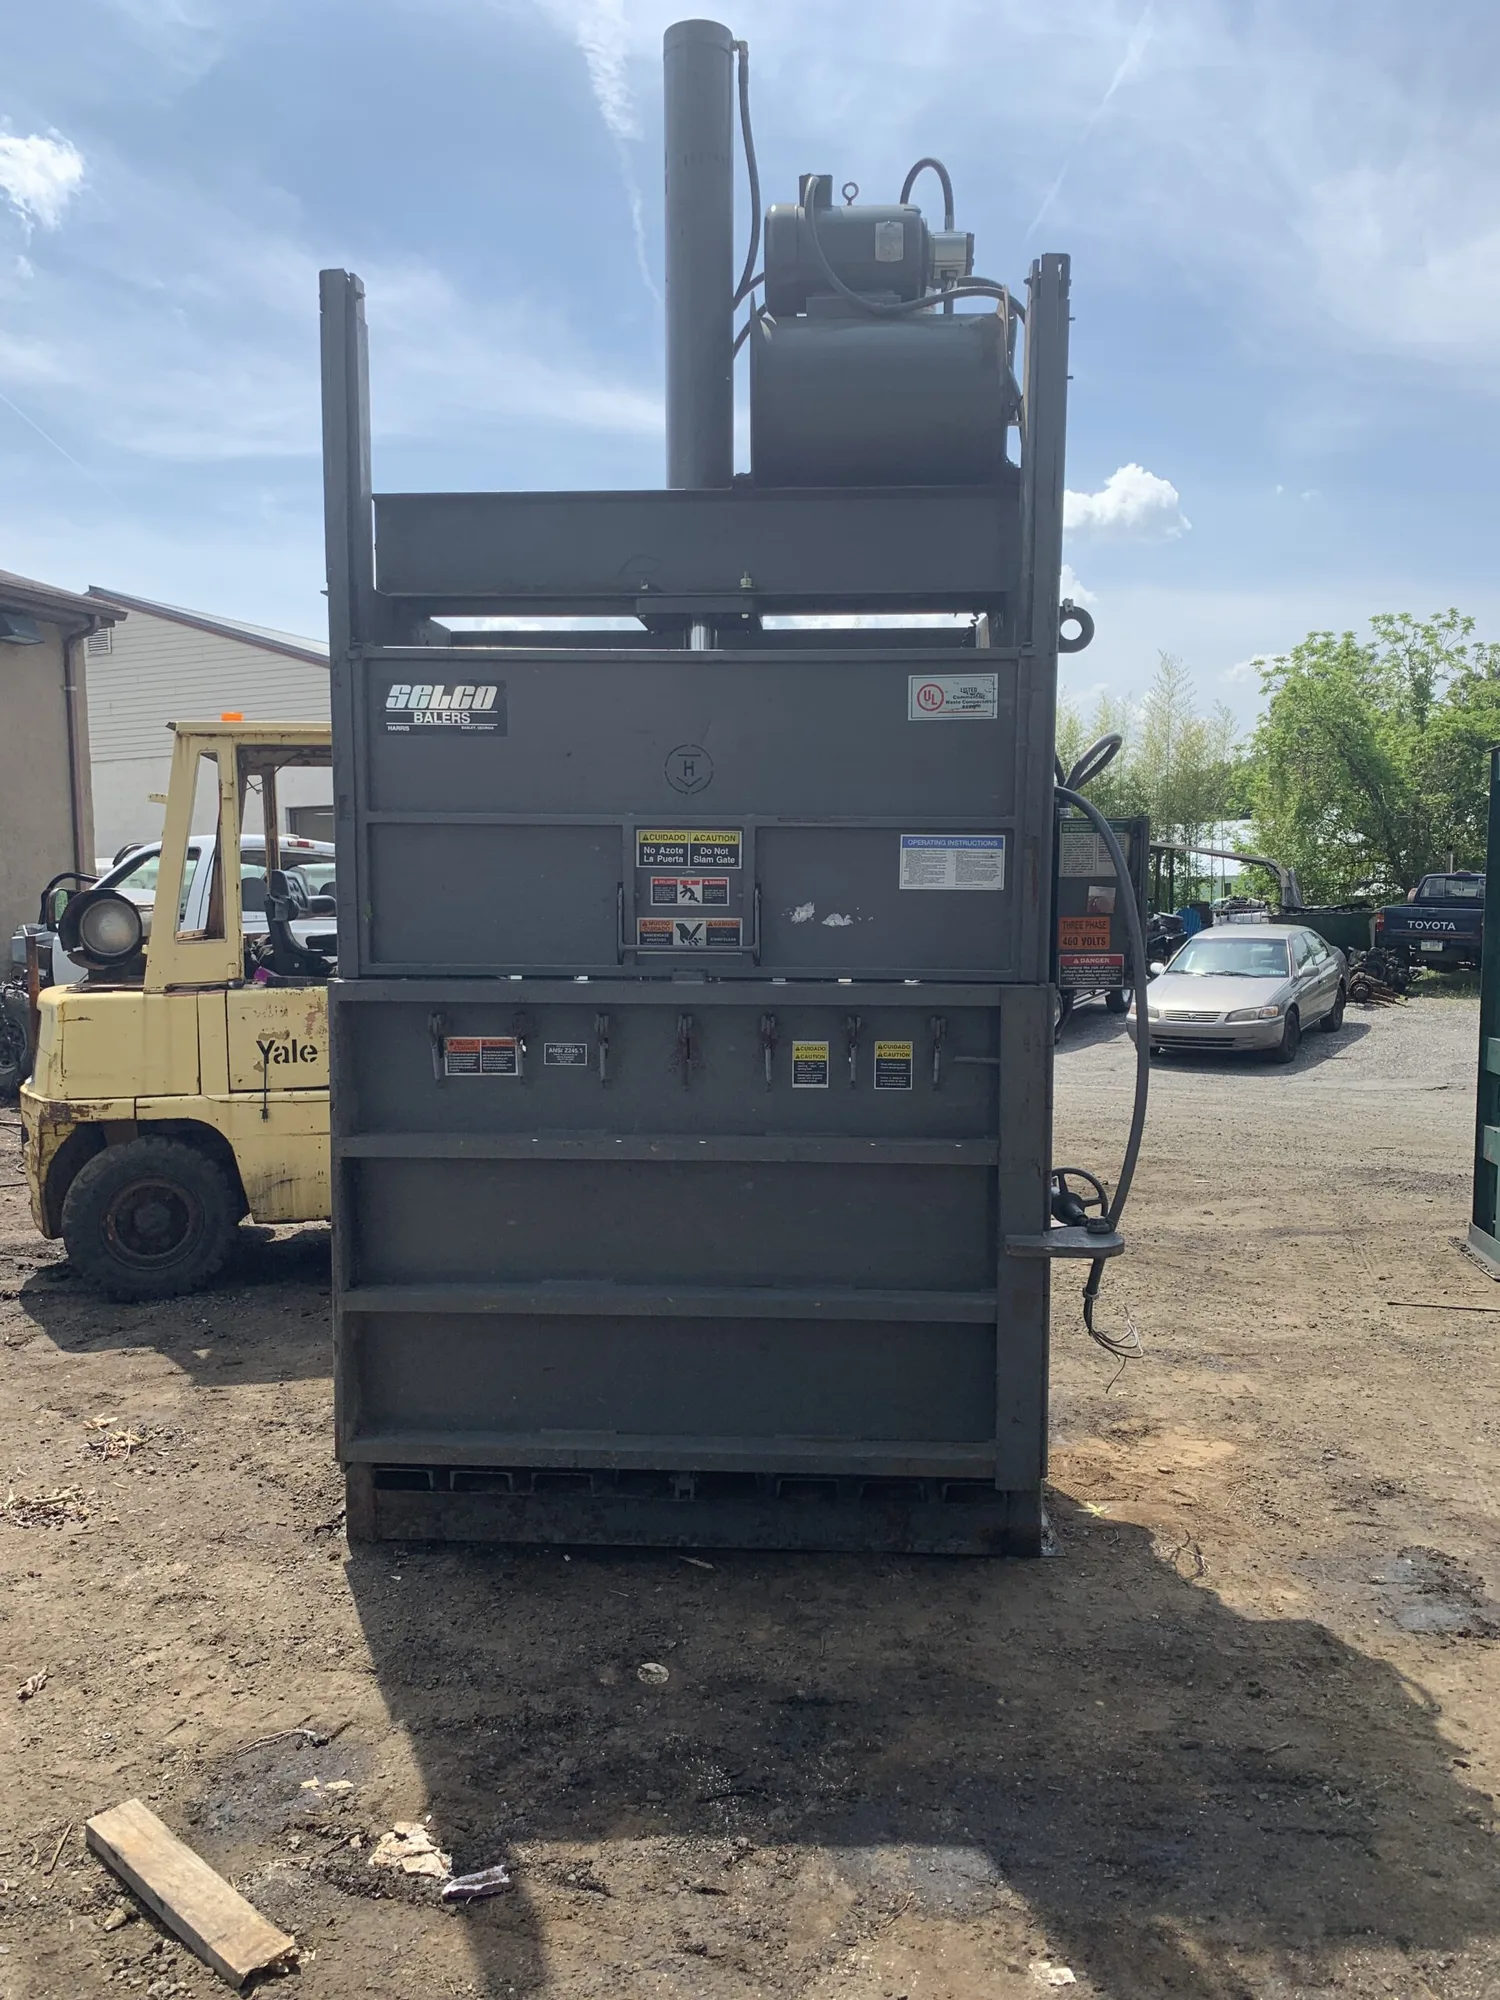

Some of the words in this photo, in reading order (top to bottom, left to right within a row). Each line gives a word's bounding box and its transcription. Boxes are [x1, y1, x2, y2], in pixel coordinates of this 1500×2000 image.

[385, 684, 498, 709] SELCO
[924, 689, 937, 705] UL
[413, 711, 471, 724] BALERS
[649, 833, 686, 841] CUIDADO
[700, 834, 736, 842] CAUTION
[947, 839, 998, 847] INSTRUCTIONS
[643, 846, 656, 854] No
[659, 846, 684, 854] Azote
[700, 847, 712, 855] Do
[714, 847, 729, 855] Not
[643, 855, 654, 863] La
[657, 855, 684, 863] Puerta
[693, 855, 714, 863] Slam
[716, 856, 735, 864] Gate
[1062, 920, 1084, 930] THREE
[1085, 920, 1107, 930] PHASE
[1407, 920, 1456, 930] TOYOTA
[1062, 936, 1078, 946] 460
[1081, 936, 1107, 946] VOLTS
[256, 1038, 318, 1064] Yale
